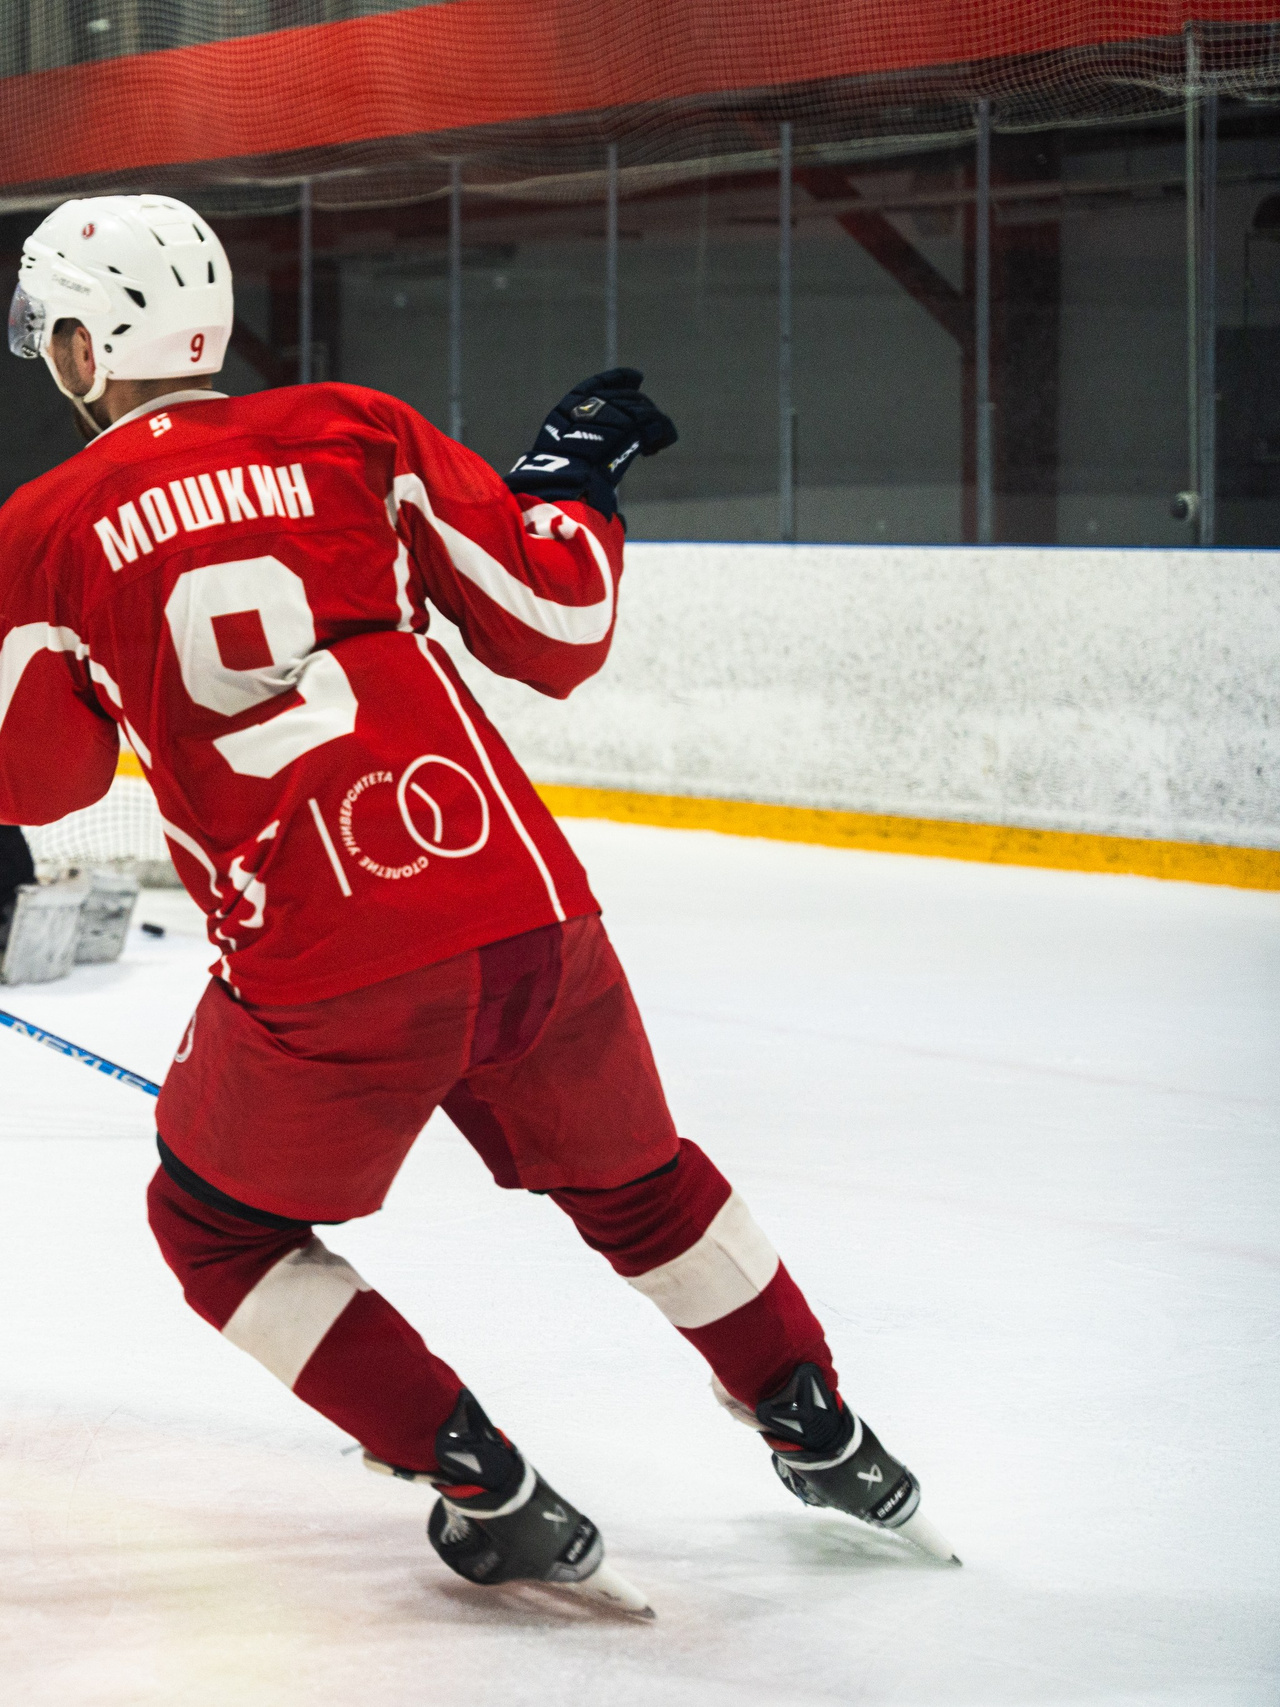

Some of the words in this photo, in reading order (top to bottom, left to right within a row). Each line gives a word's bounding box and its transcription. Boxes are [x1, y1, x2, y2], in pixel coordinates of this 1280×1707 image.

[190, 333, 205, 363] 9
[93, 462, 315, 573] МОШКИН
[164, 554, 359, 779] 9
[339, 770, 393, 856] УНИВЕРСИТЕТА
[358, 855, 429, 880] СТОЛЕТИЕ
